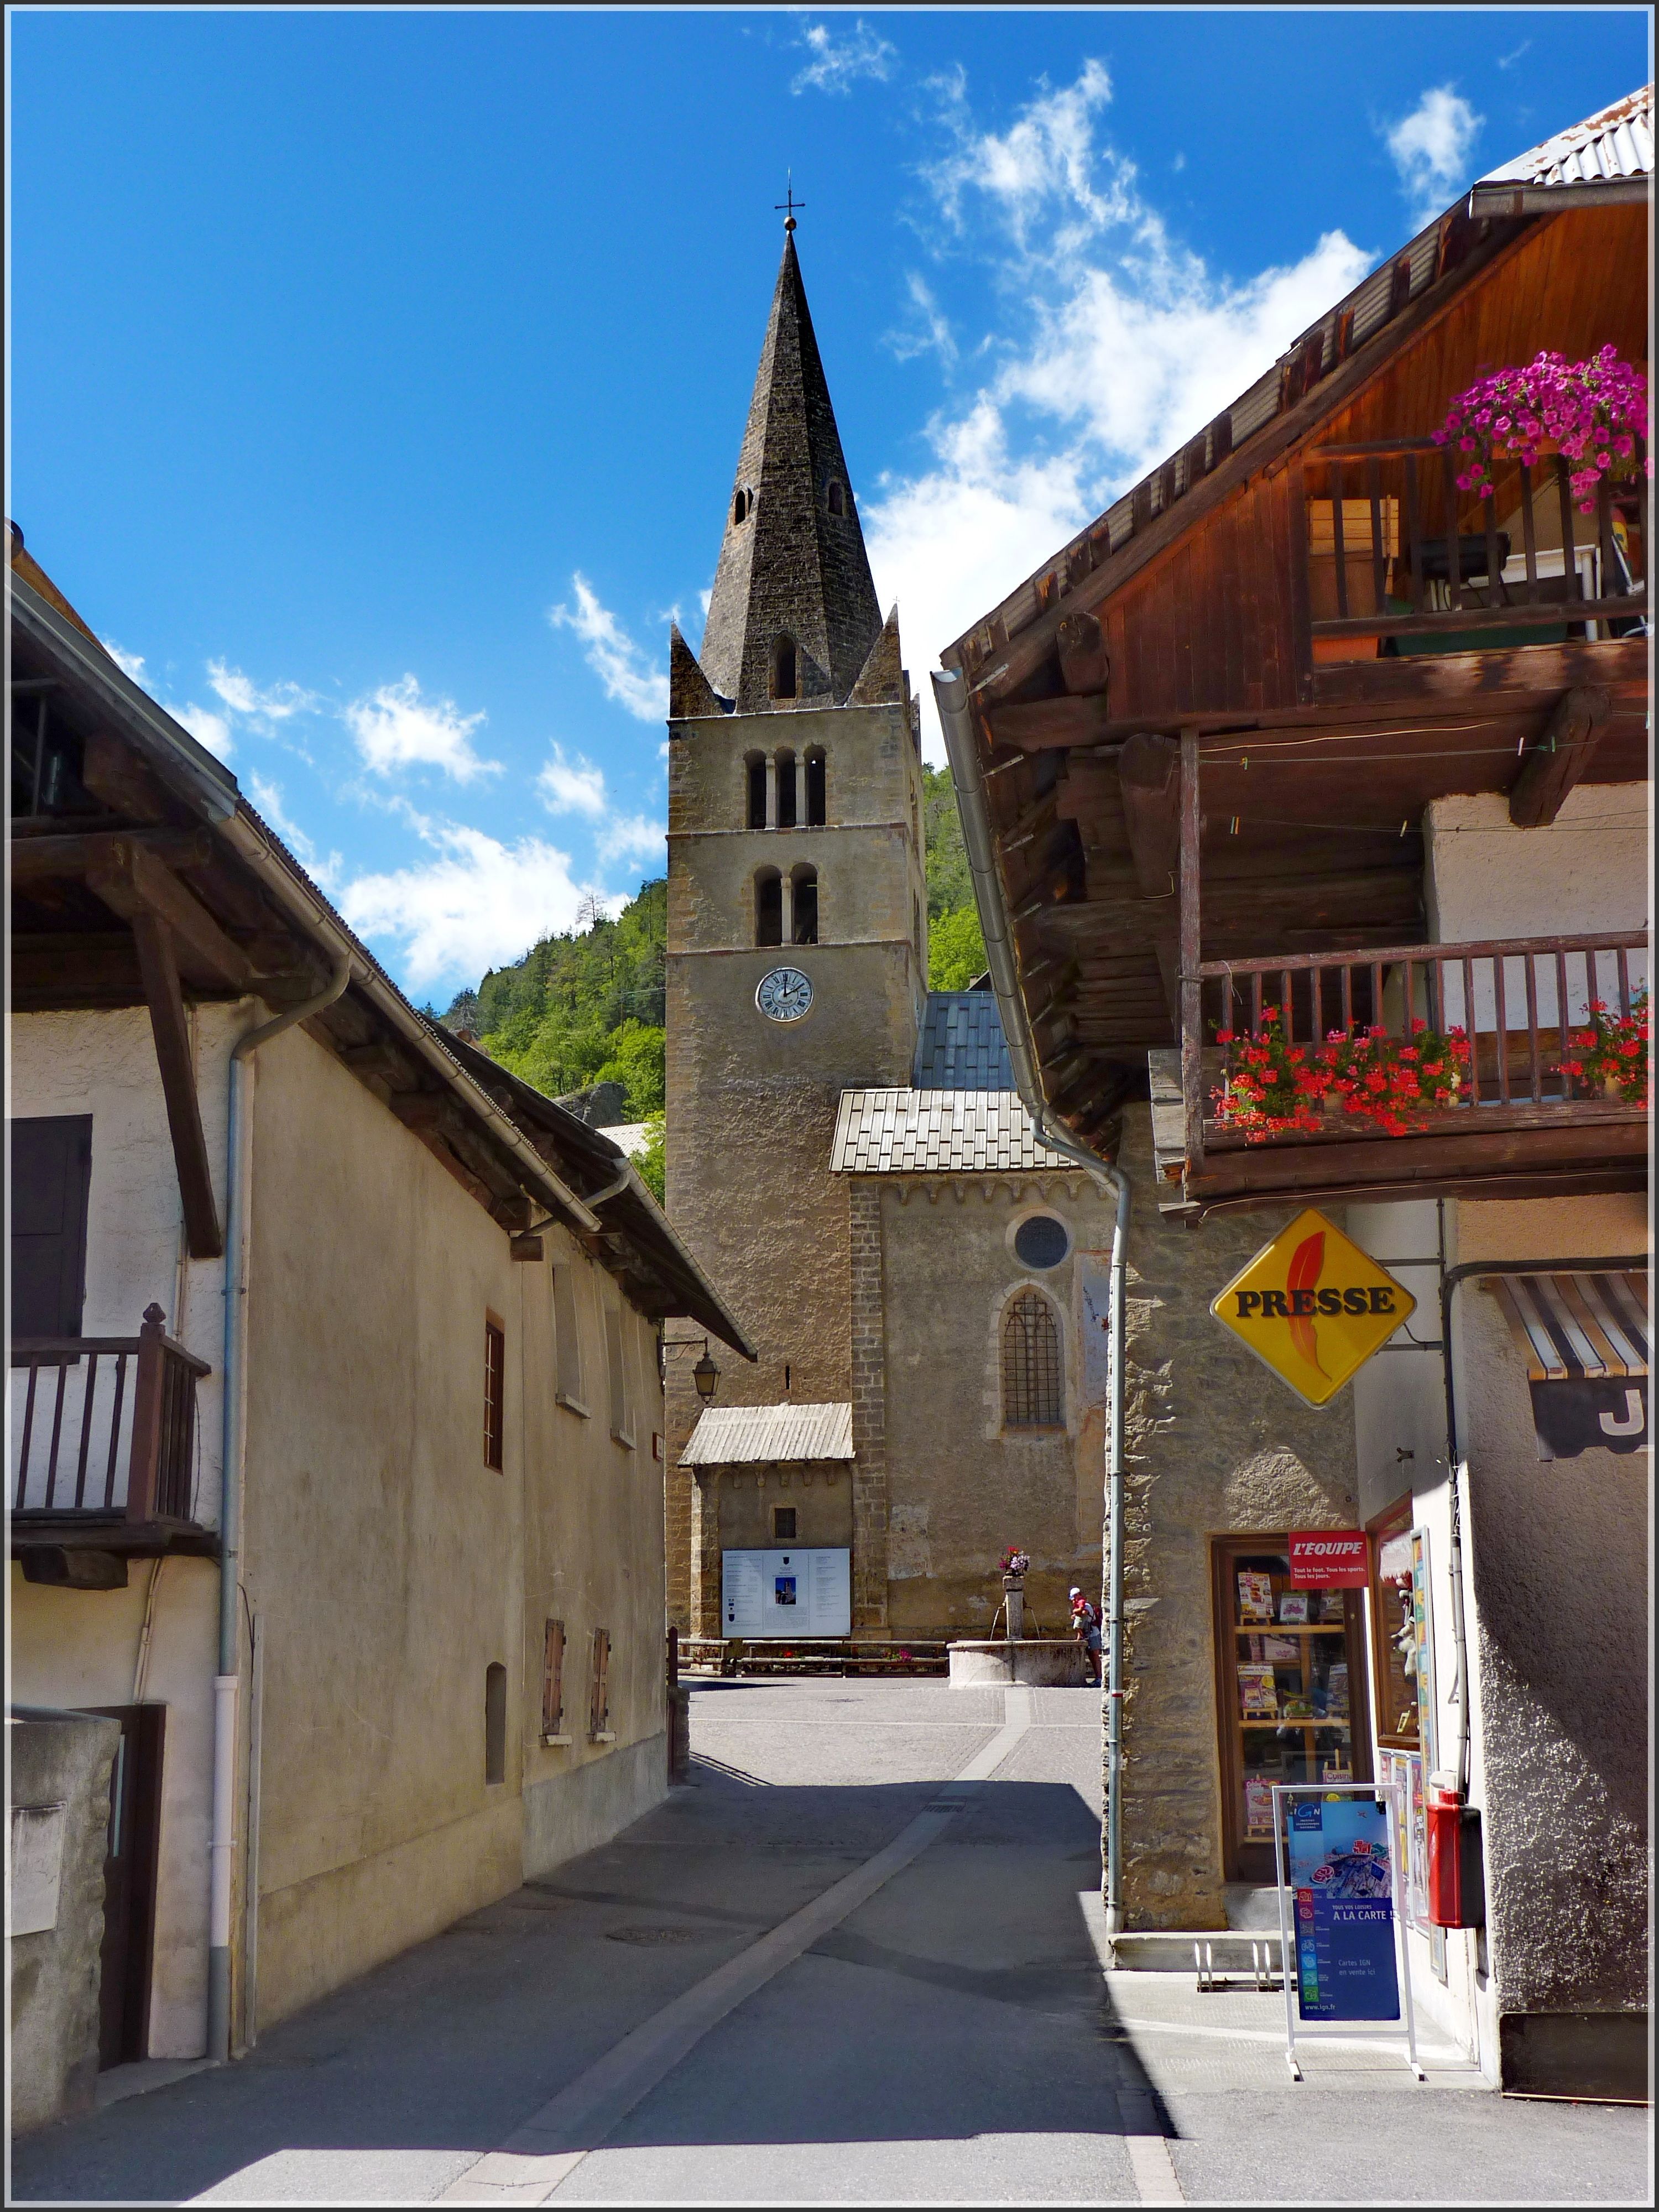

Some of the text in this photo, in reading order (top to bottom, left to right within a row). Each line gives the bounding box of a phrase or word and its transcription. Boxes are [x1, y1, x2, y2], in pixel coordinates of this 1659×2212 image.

[1235, 1287, 1395, 1317] PRESSE
[1599, 1389, 1645, 1436] J
[1294, 1804, 1320, 1818] IGN
[1333, 1911, 1340, 1920] A
[1343, 1911, 1355, 1920] LA
[1358, 1911, 1386, 1920] CARTE
